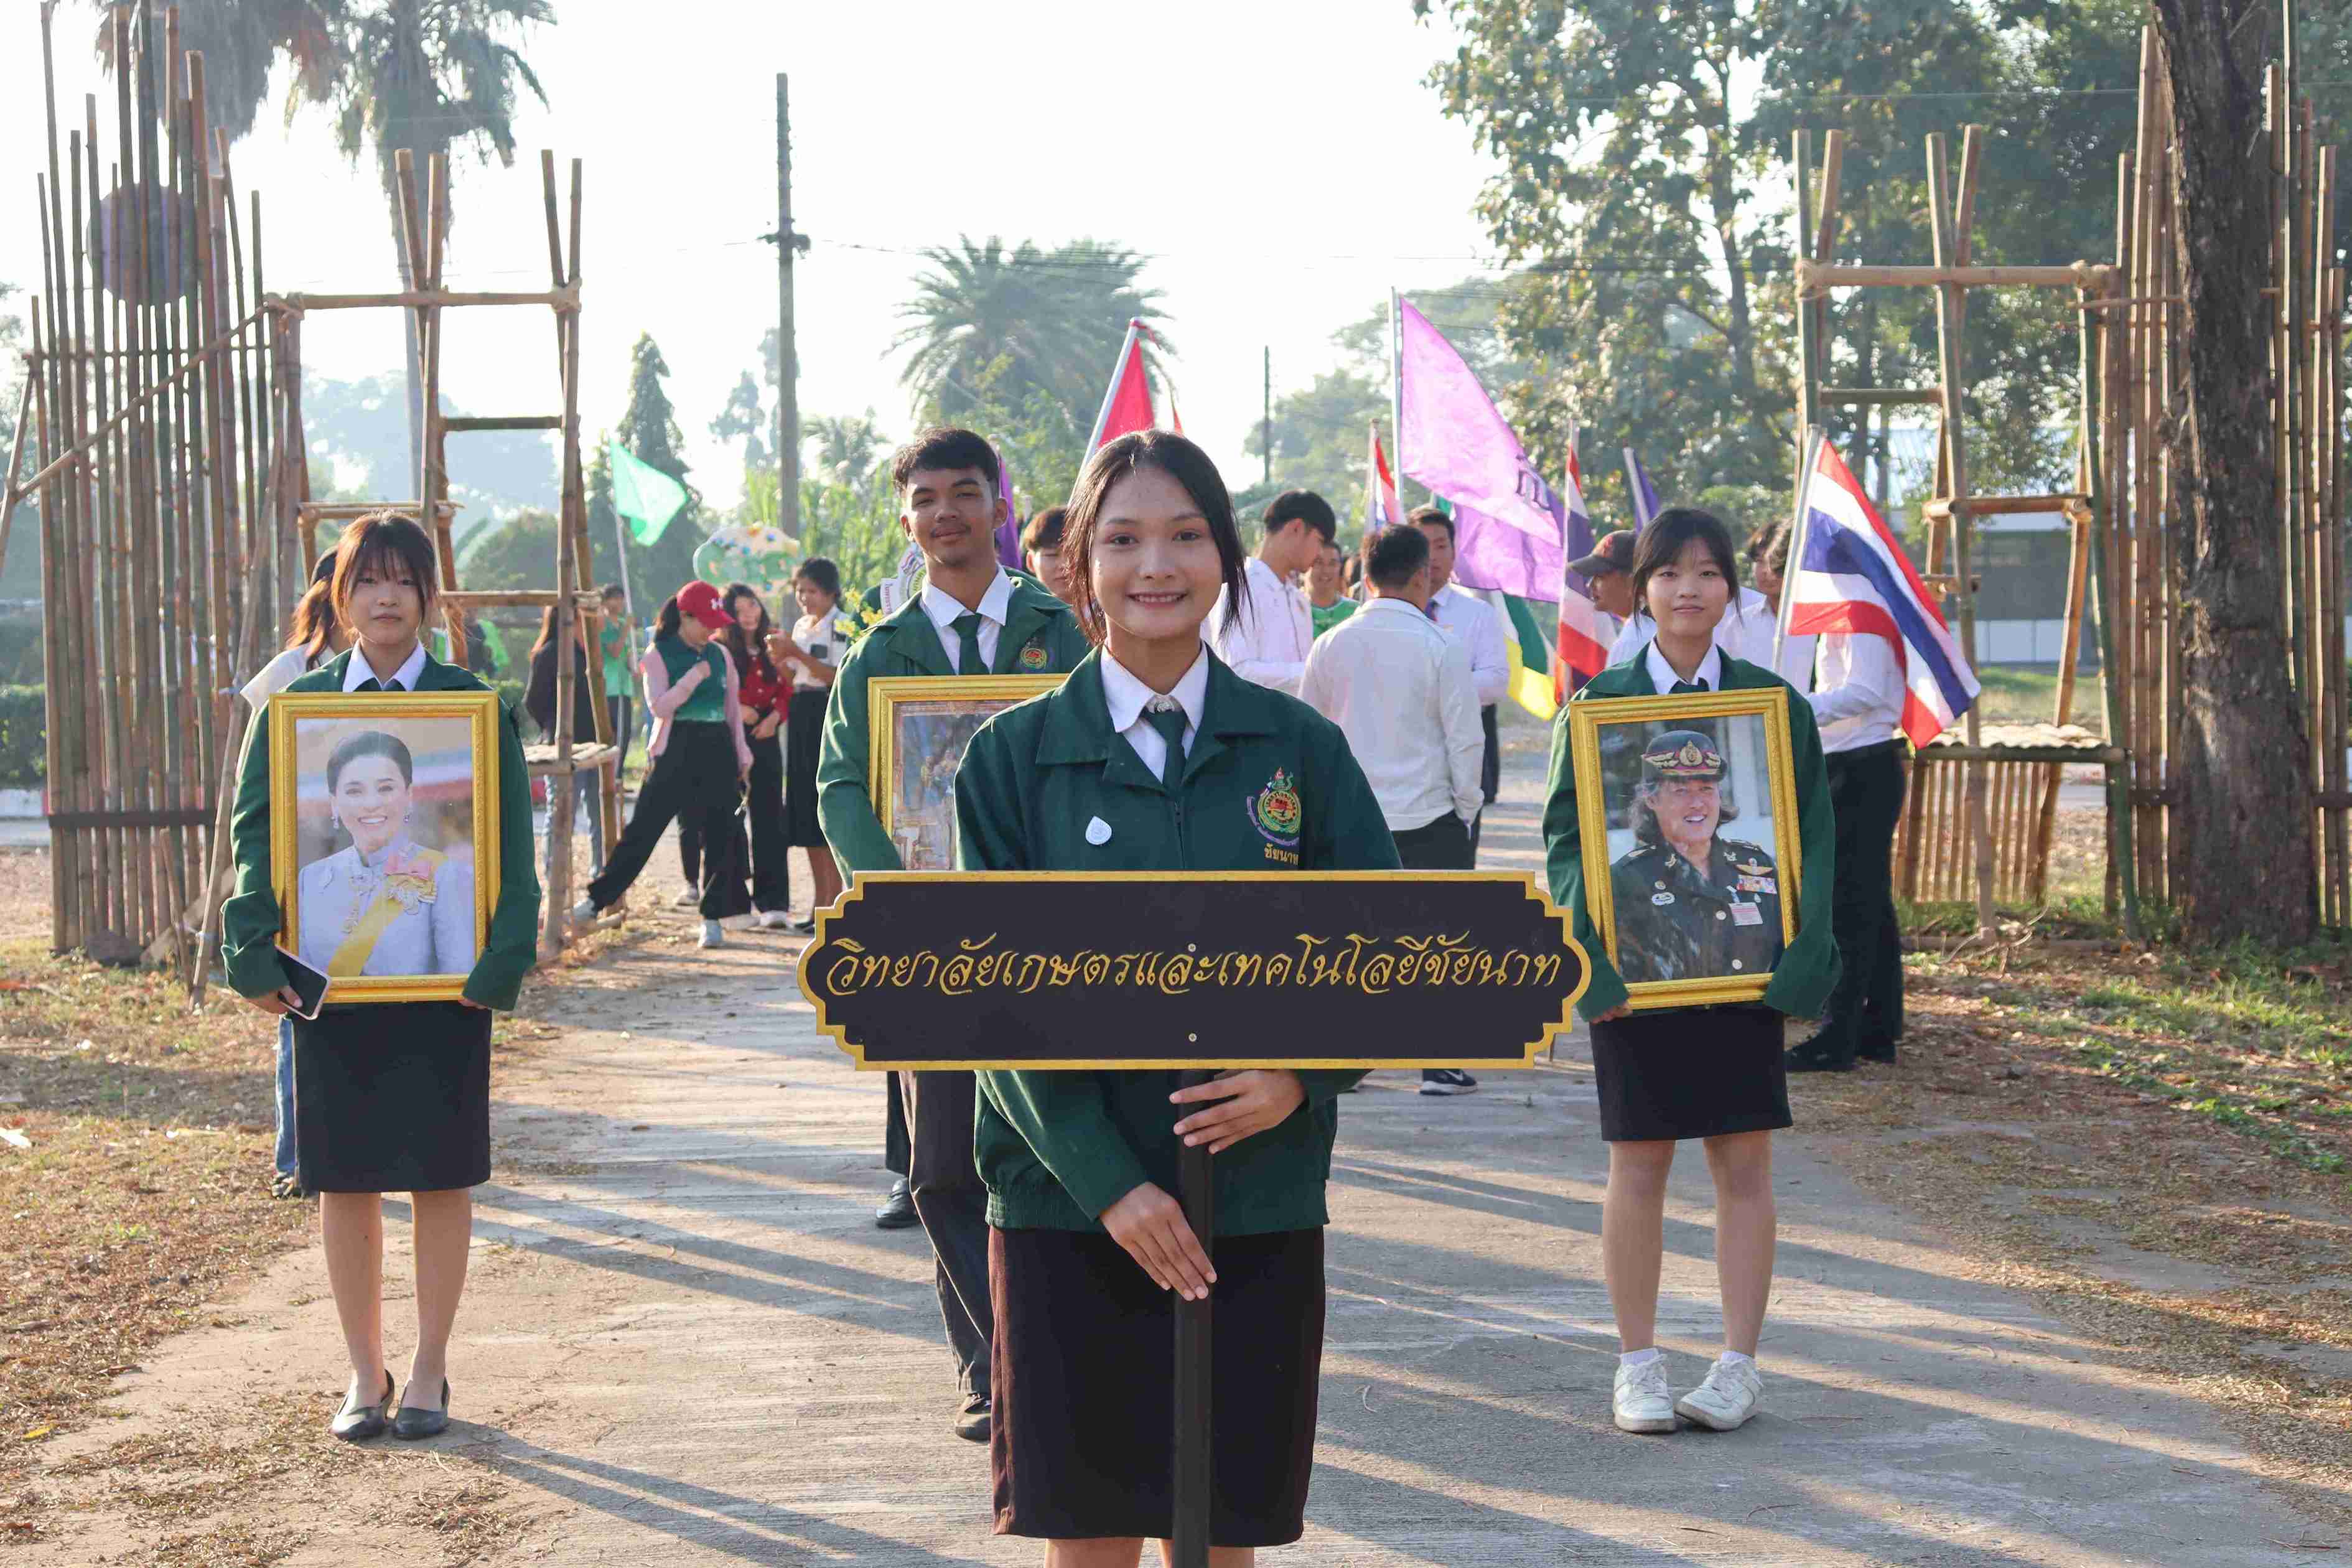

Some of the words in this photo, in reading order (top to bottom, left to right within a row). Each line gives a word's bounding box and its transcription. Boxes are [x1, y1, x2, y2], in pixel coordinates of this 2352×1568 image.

[1264, 843, 1300, 866] ชัยนาท
[826, 931, 1561, 996] วิทยาลัยเกษตรและเทคโนโลยีชัยนาท
